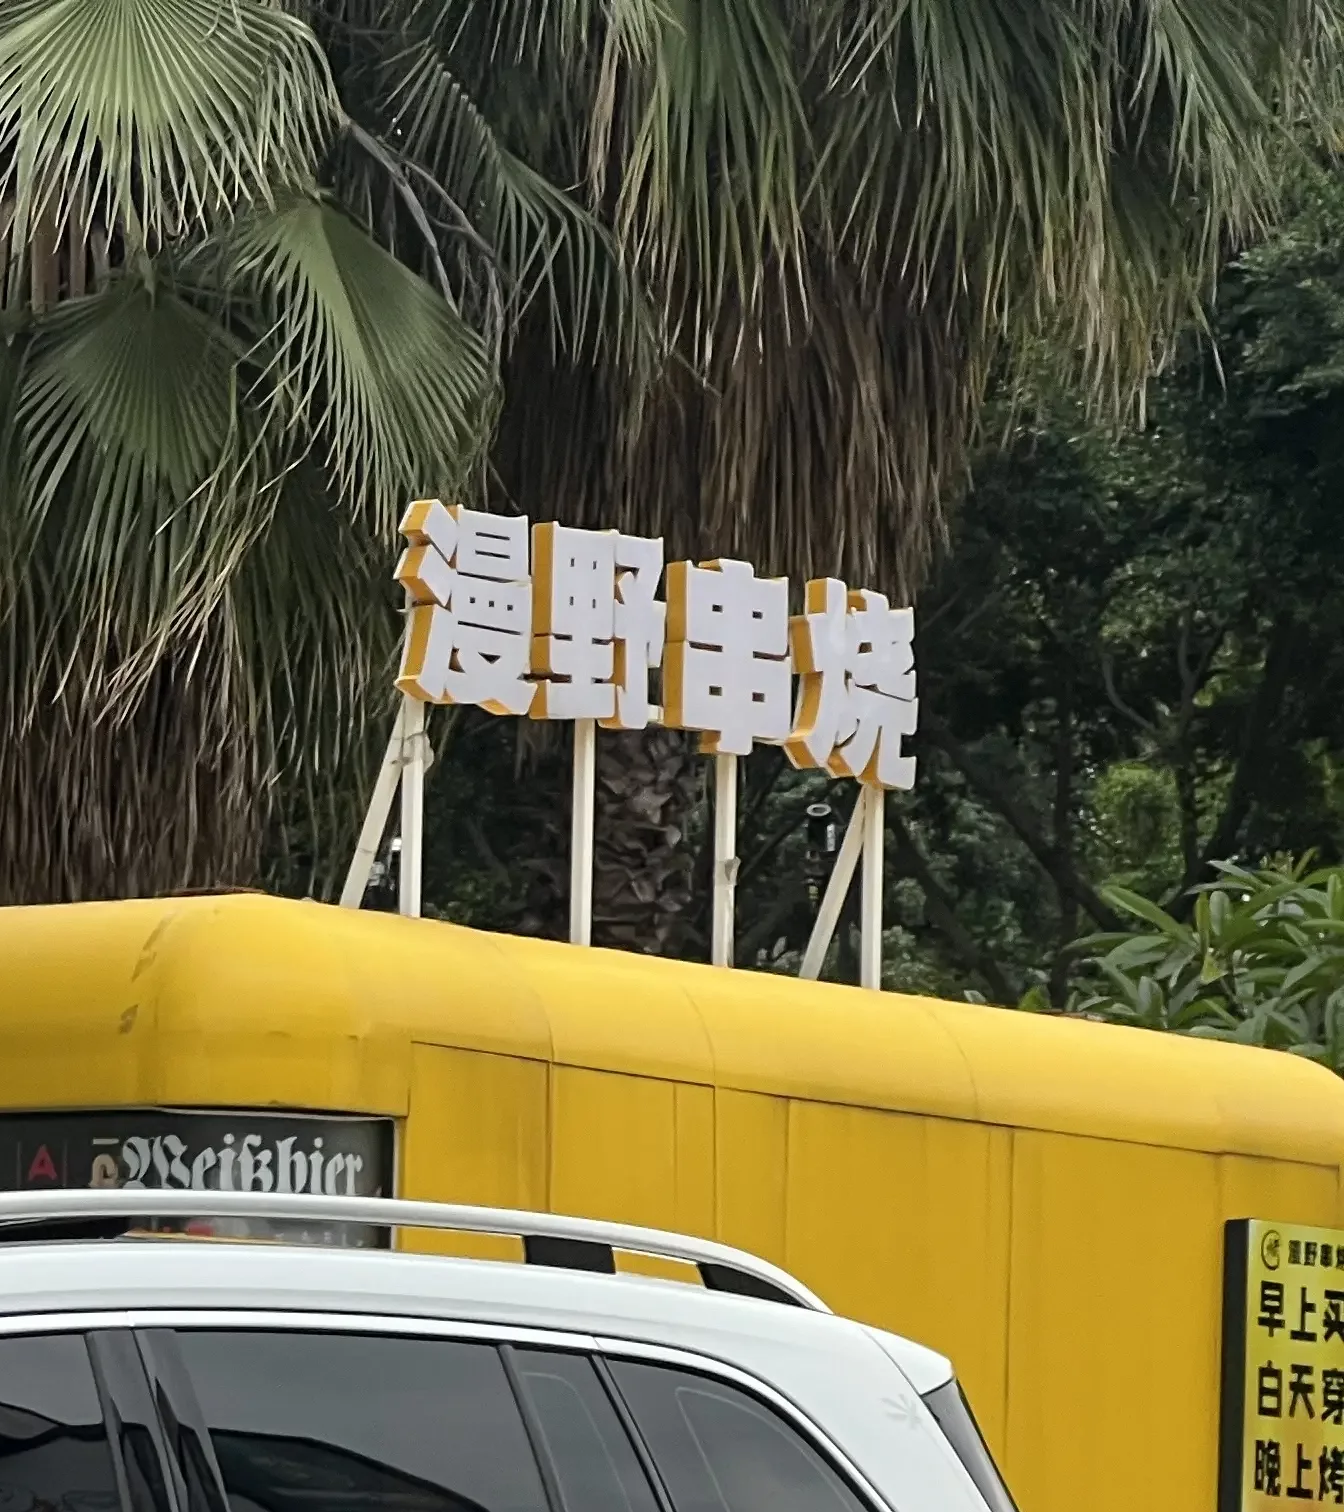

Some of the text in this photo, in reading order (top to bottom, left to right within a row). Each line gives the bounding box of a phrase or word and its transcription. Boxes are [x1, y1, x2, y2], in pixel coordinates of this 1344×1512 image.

[393, 498, 919, 790] 漫野串烧
[1257, 1280, 1344, 1342] 早上买
[1257, 1360, 1344, 1426] 白天穿
